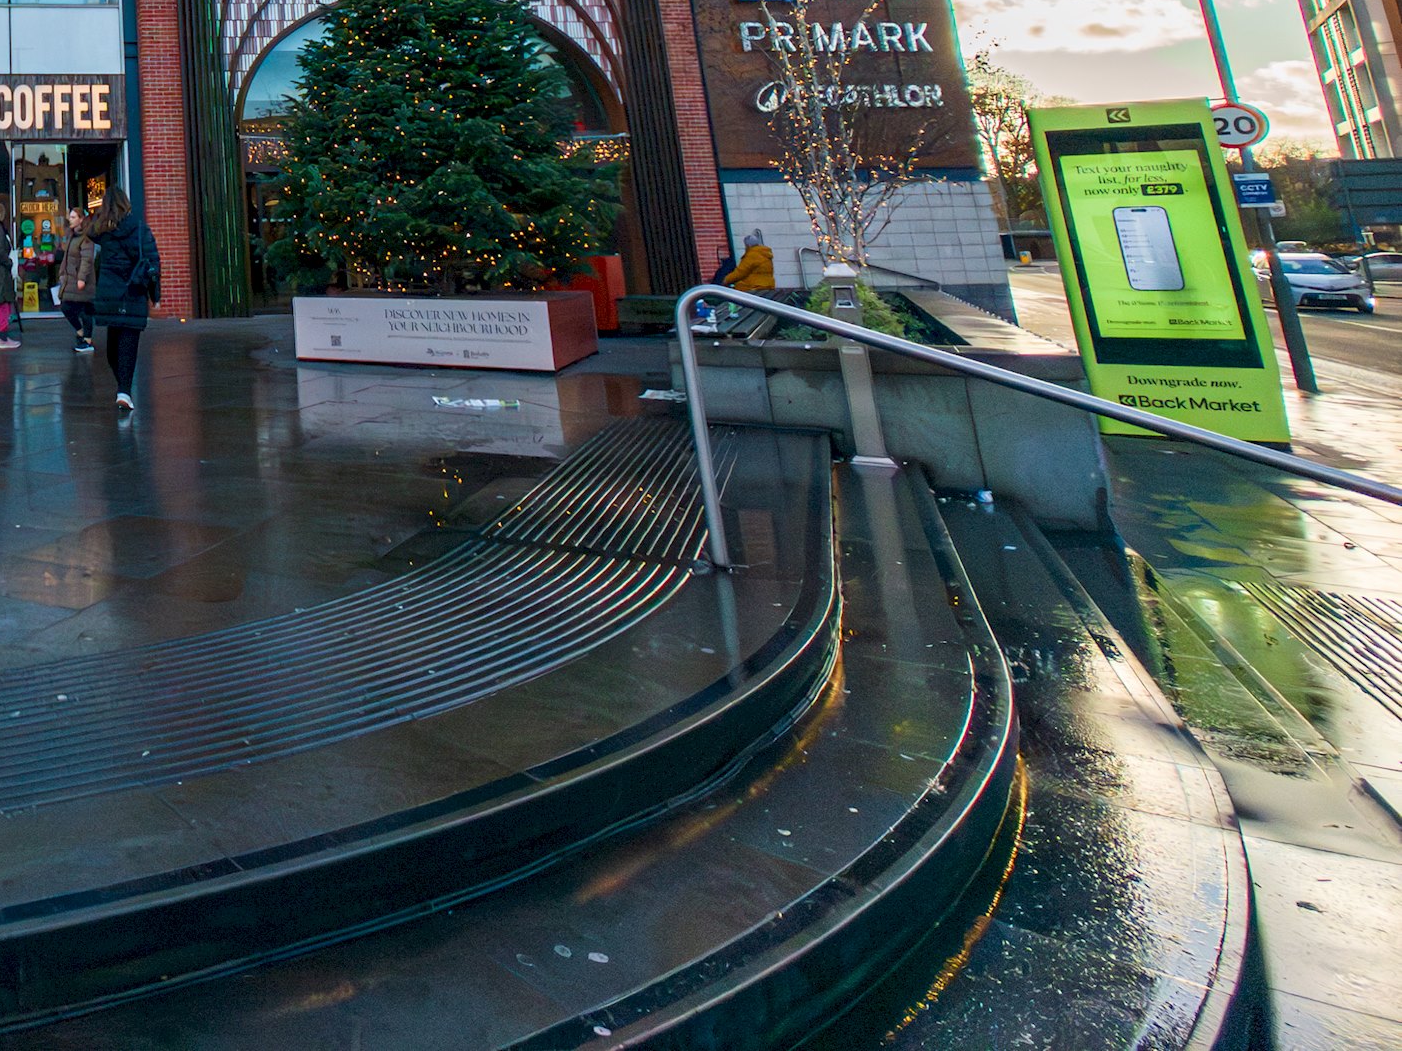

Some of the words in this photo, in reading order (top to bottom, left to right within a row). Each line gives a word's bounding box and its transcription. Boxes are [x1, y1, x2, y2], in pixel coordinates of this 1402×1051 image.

[739, 21, 934, 52] PRMARK
[1213, 116, 1256, 136] 20
[1075, 165, 1100, 174] Text
[1101, 165, 1131, 176] your
[1136, 161, 1188, 173] naughty
[1084, 188, 1110, 196] now
[1112, 185, 1140, 196] only
[384, 308, 441, 321] DISCOVER
[388, 320, 419, 332] YOUR
[1127, 375, 1207, 389] Downgrade
[1211, 381, 1242, 389] now.
[1138, 395, 1187, 409] Back
[1189, 397, 1262, 413] Market
